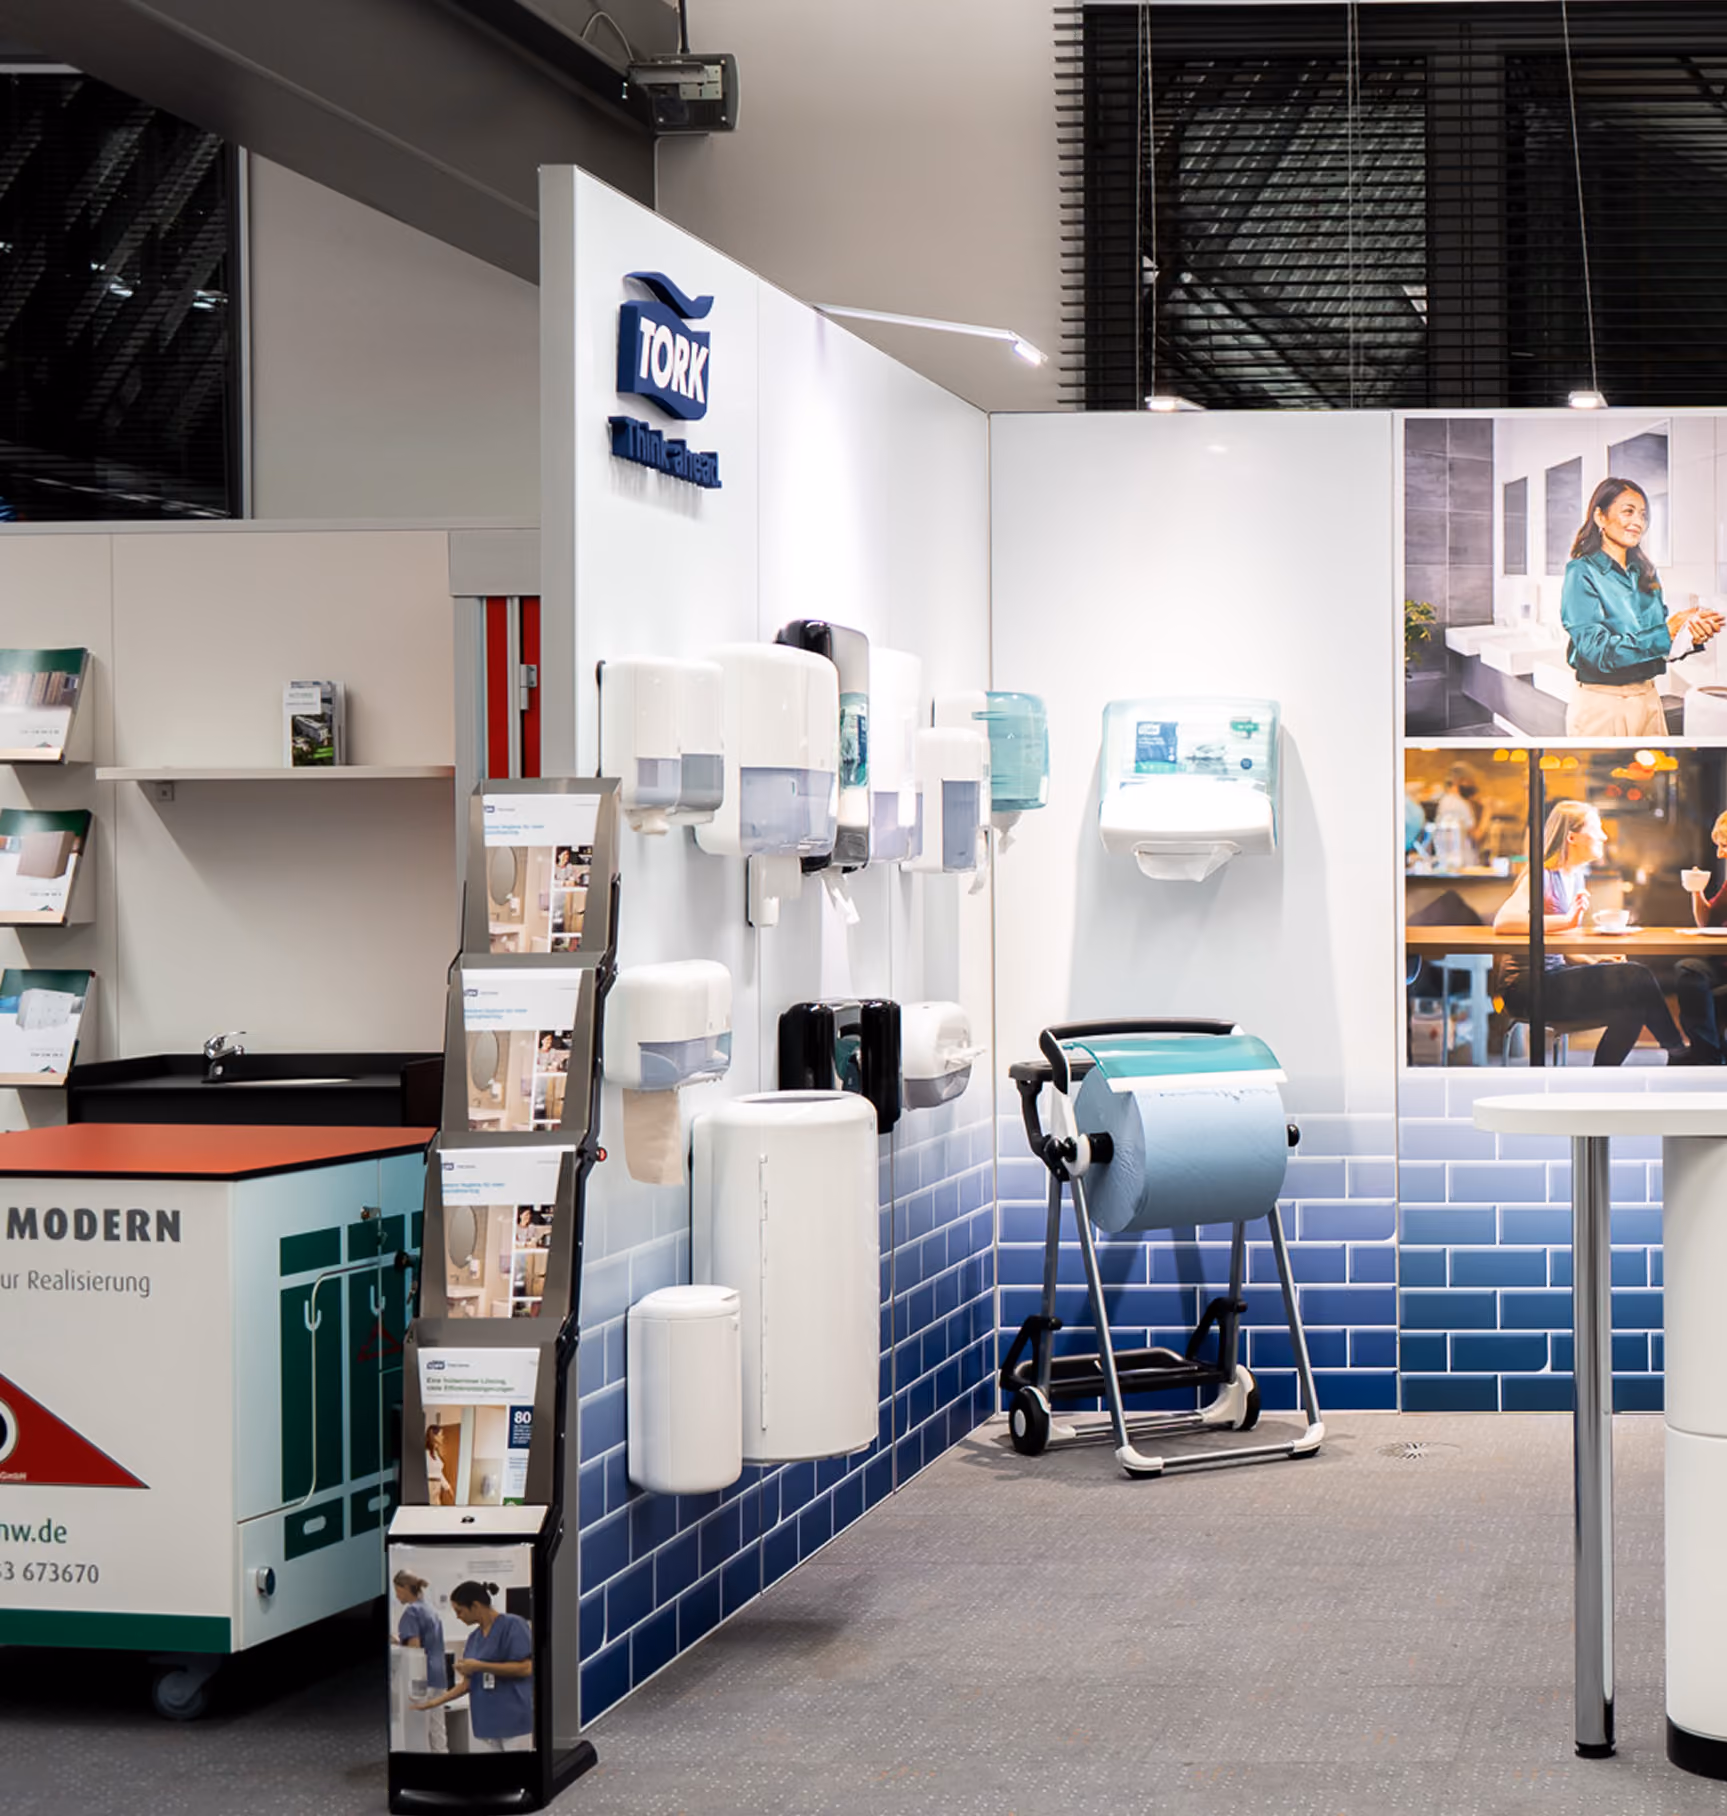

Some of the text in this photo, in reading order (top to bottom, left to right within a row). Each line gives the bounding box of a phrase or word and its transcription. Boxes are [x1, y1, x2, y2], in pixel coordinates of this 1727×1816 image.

[639, 315, 709, 404] TORK
[608, 415, 672, 472] Think
[6, 1207, 181, 1243] MODERN
[0, 1268, 151, 1299] ur Realisierung
[0, 1517, 68, 1544] nw.de
[0, 1560, 100, 1584] 3 673670
